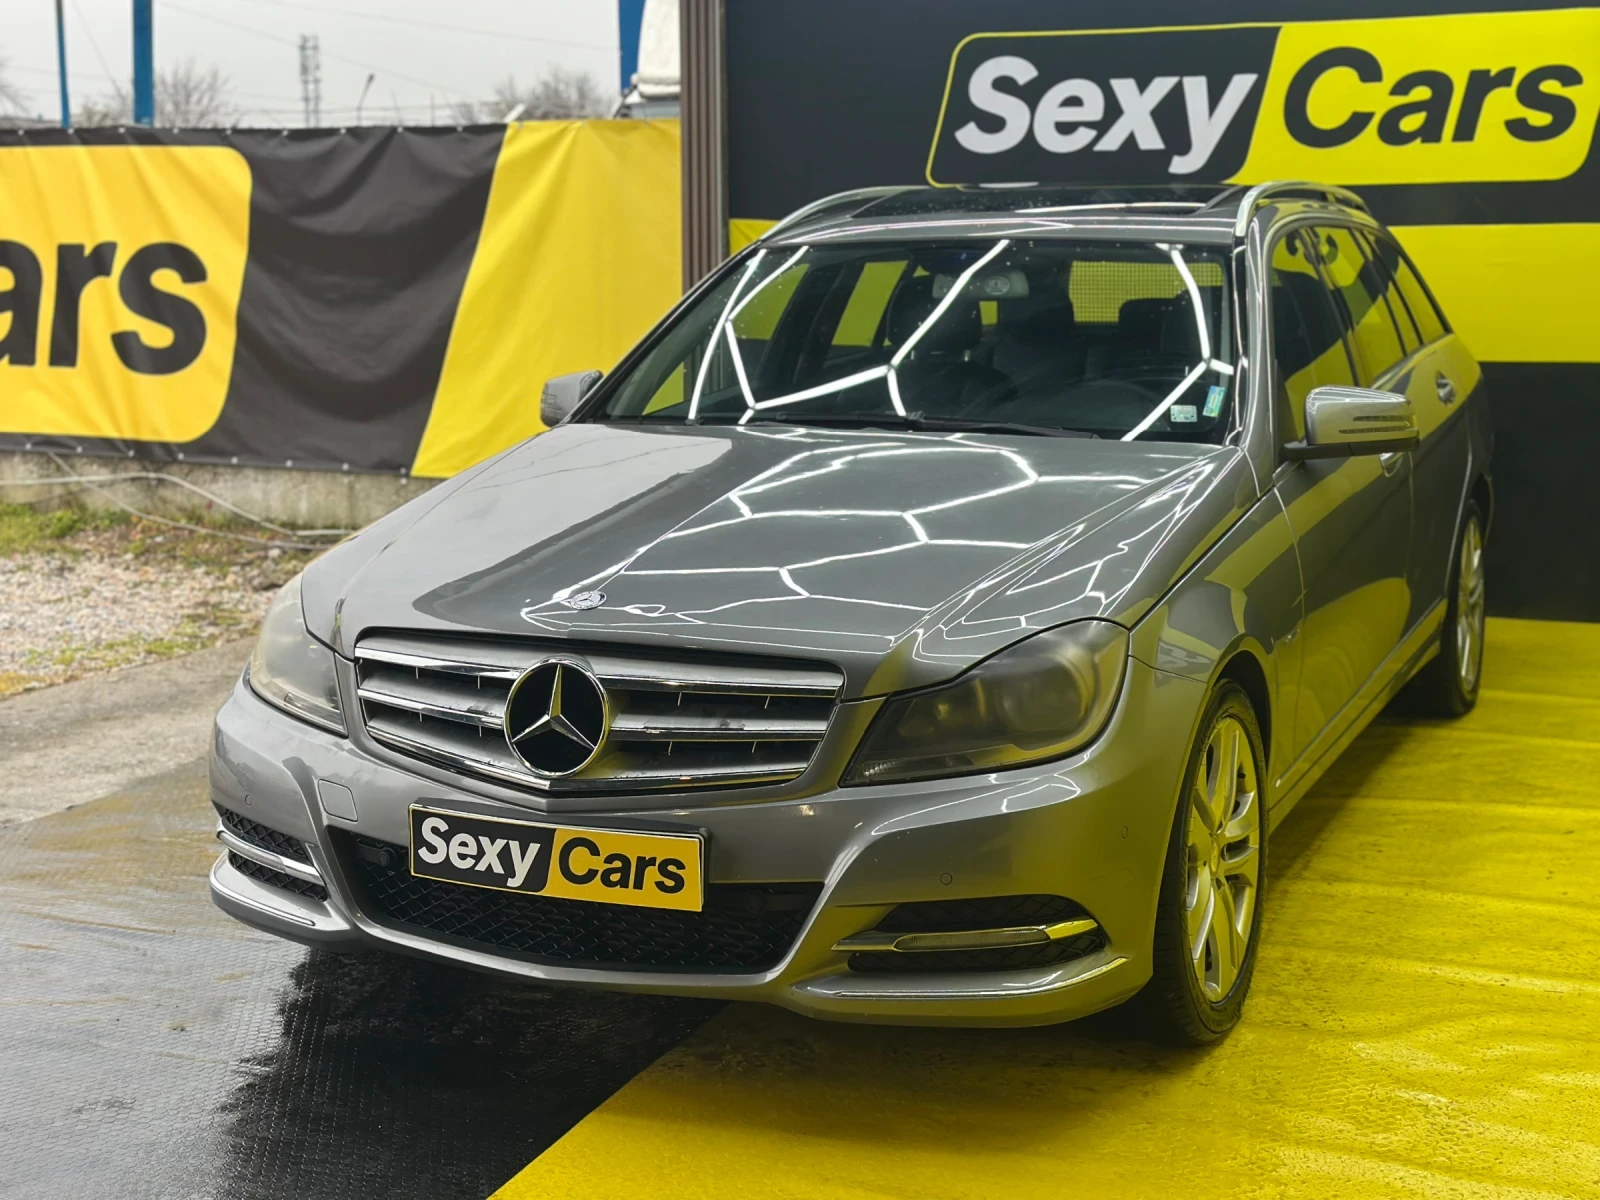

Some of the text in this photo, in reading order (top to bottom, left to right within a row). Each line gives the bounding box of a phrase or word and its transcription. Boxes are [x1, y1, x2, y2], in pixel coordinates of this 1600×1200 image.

[954, 46, 1584, 175] Sexy Cars
[417, 816, 686, 894] Sexy Cars
